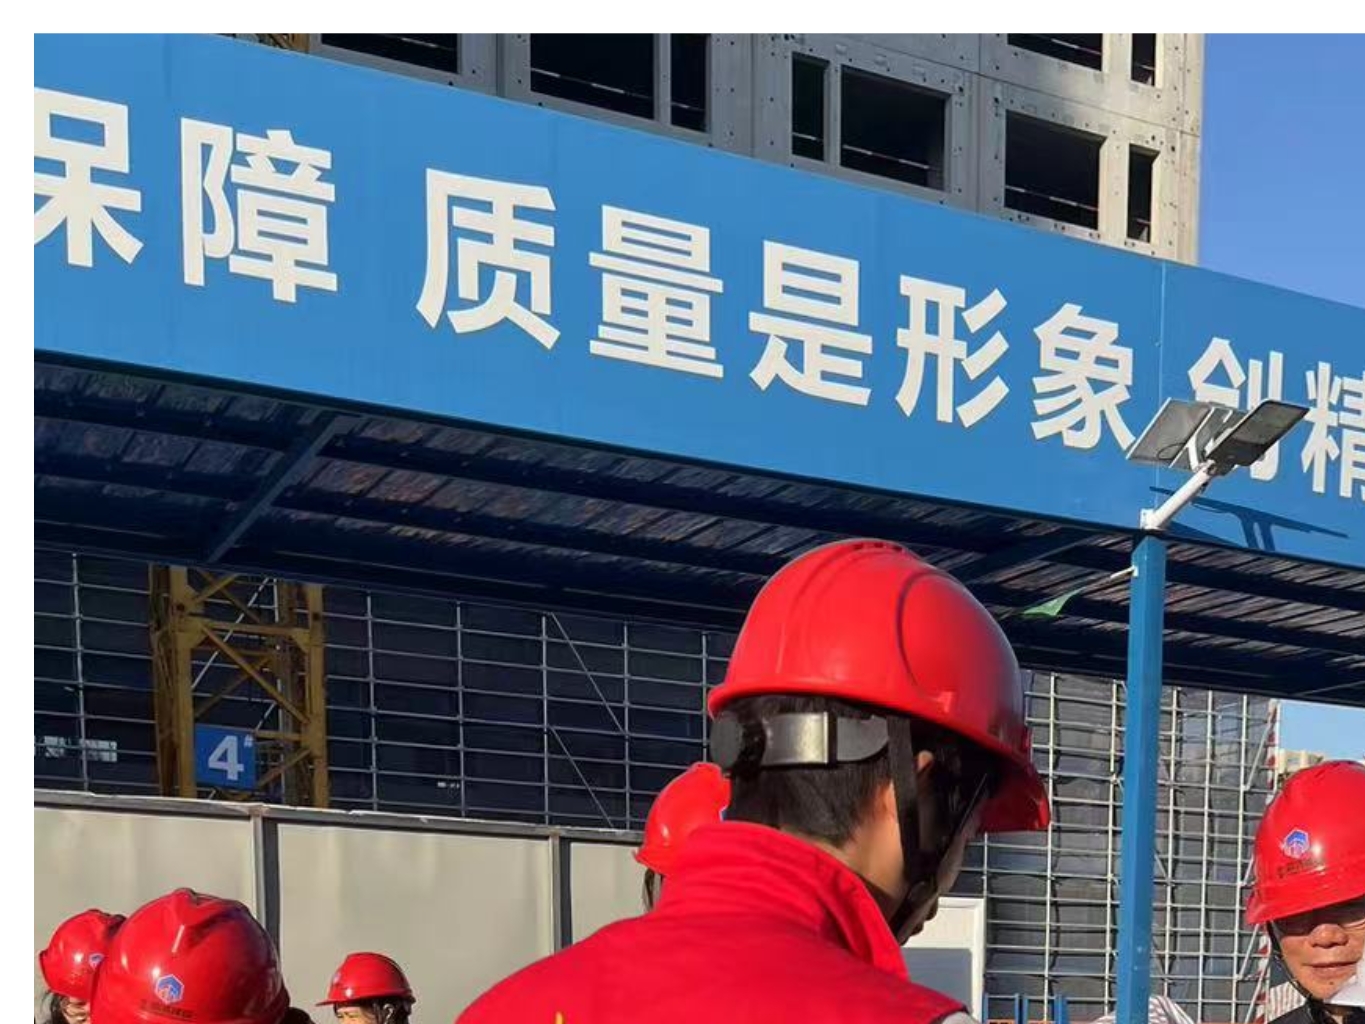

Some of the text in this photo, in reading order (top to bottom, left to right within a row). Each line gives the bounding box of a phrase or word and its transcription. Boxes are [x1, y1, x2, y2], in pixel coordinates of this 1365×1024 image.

[416, 167, 1135, 450] 质量是形象
